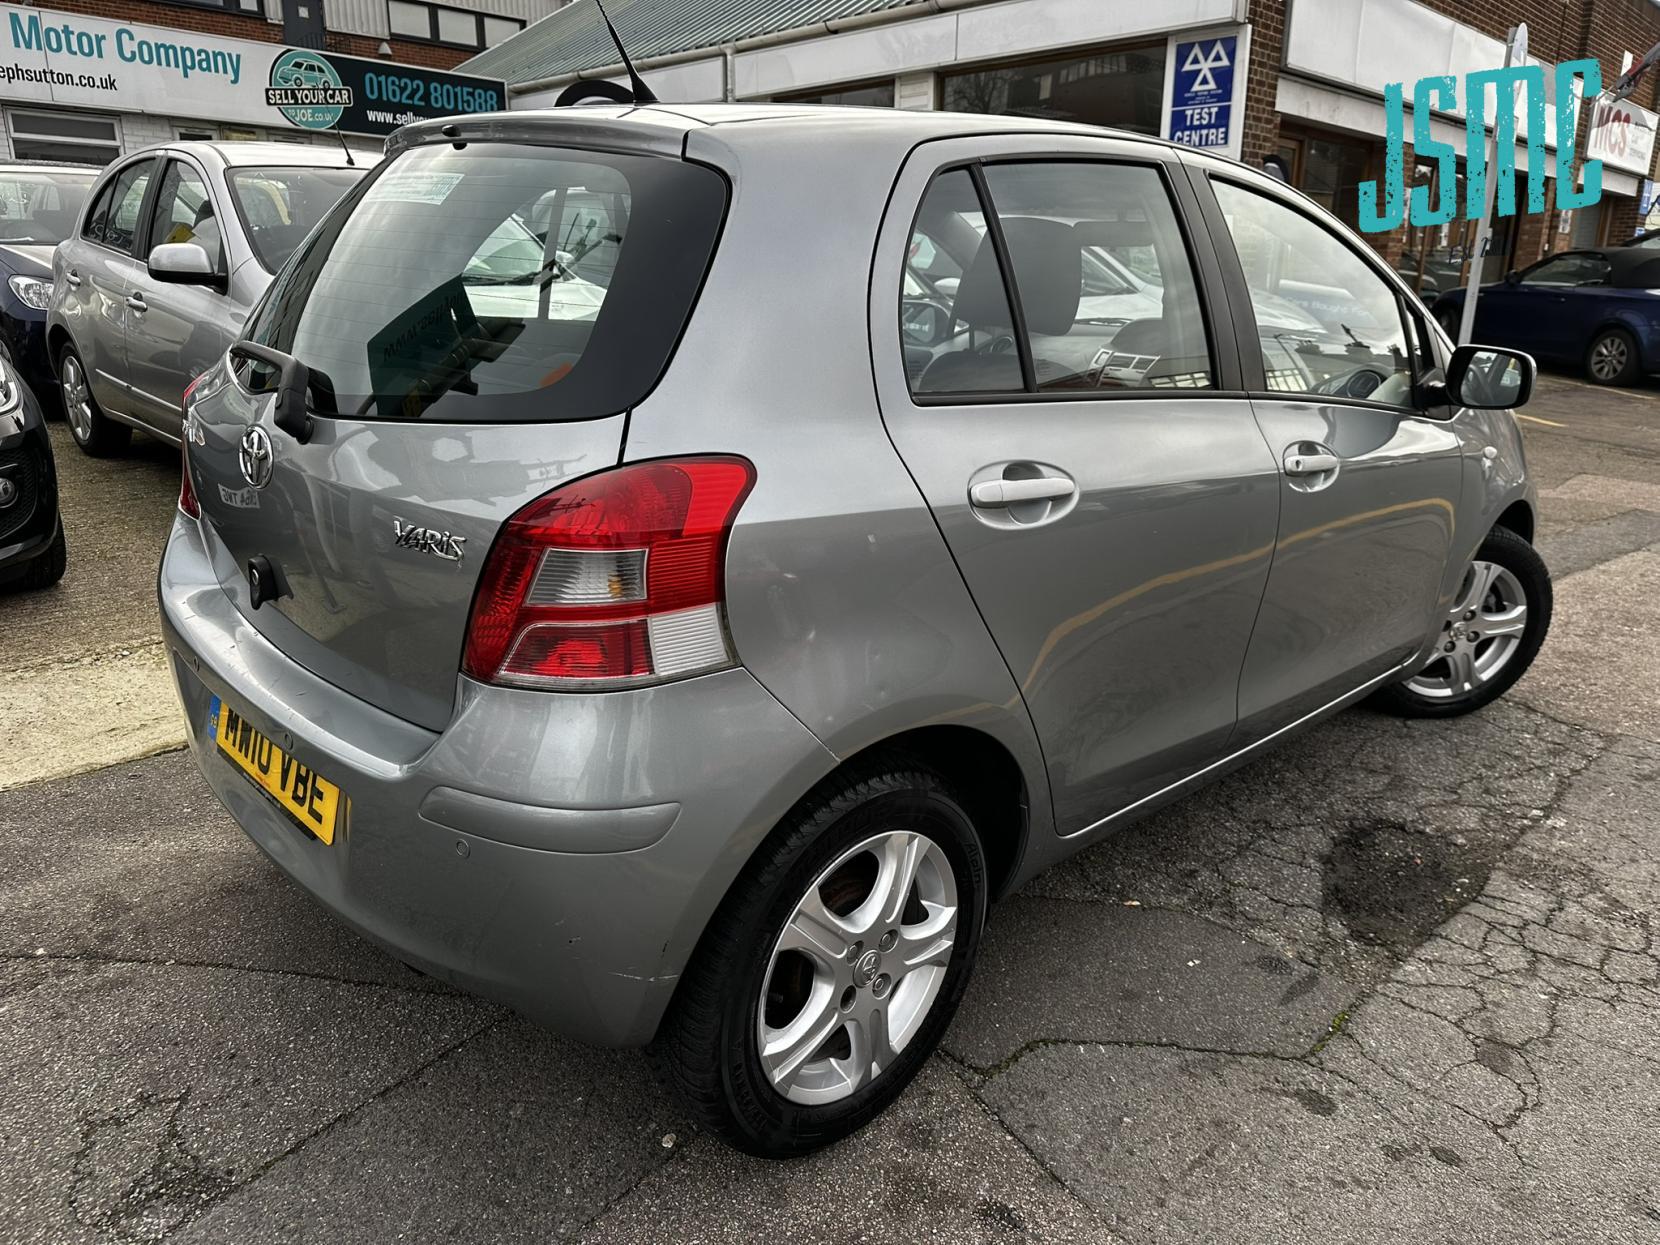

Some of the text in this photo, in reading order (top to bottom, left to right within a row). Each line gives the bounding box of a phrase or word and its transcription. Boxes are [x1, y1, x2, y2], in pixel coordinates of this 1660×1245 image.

[9, 12, 241, 84] Motor Company
[268, 89, 349, 104] SELL YOUR CAR
[364, 72, 498, 112] 01622 801588
[1185, 107, 1218, 126] TEST
[1174, 128, 1226, 147] CENTRE
[280, 749, 324, 826] VBE
